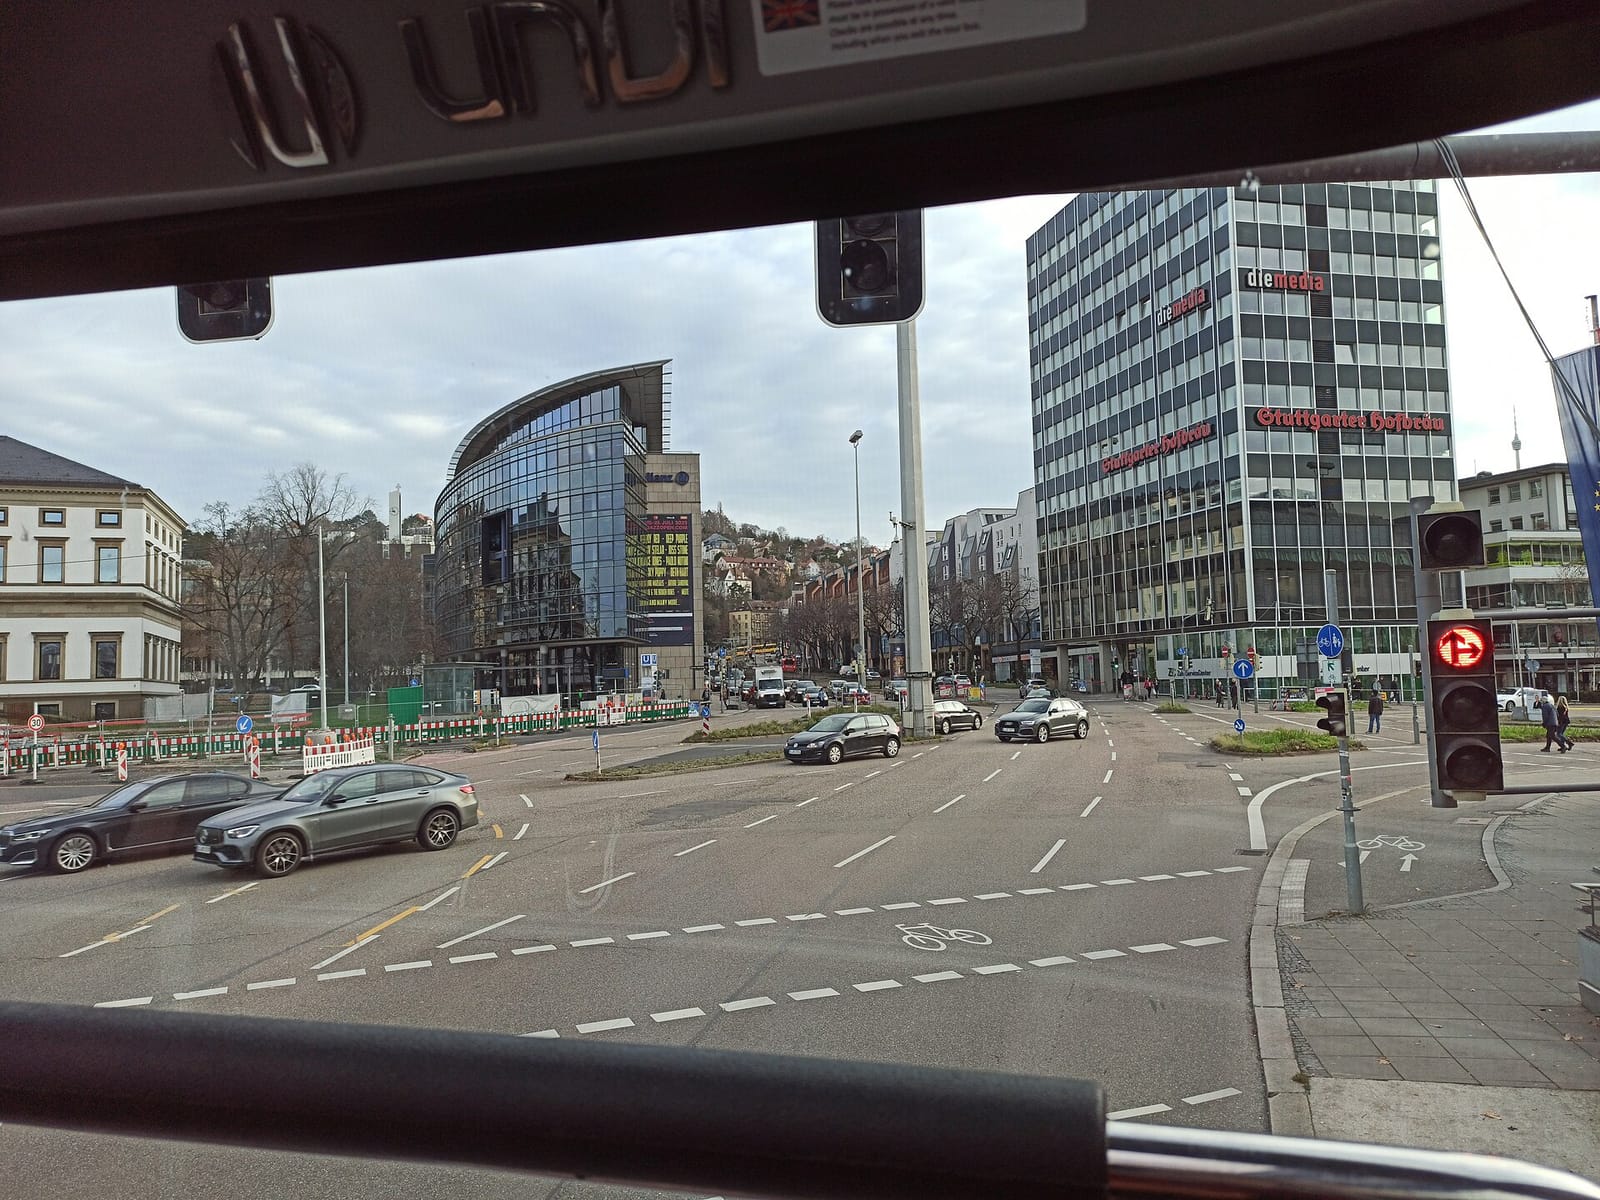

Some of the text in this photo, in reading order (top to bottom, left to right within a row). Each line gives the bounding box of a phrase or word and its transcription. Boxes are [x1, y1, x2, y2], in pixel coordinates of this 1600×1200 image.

[1247, 268, 1324, 291] diemedia
[1157, 287, 1206, 326] diemedia
[1257, 407, 1445, 432] Stuttgarter Hofbräu
[1102, 442, 1160, 474] Stuttgarter
[32, 719, 41, 727] 30
